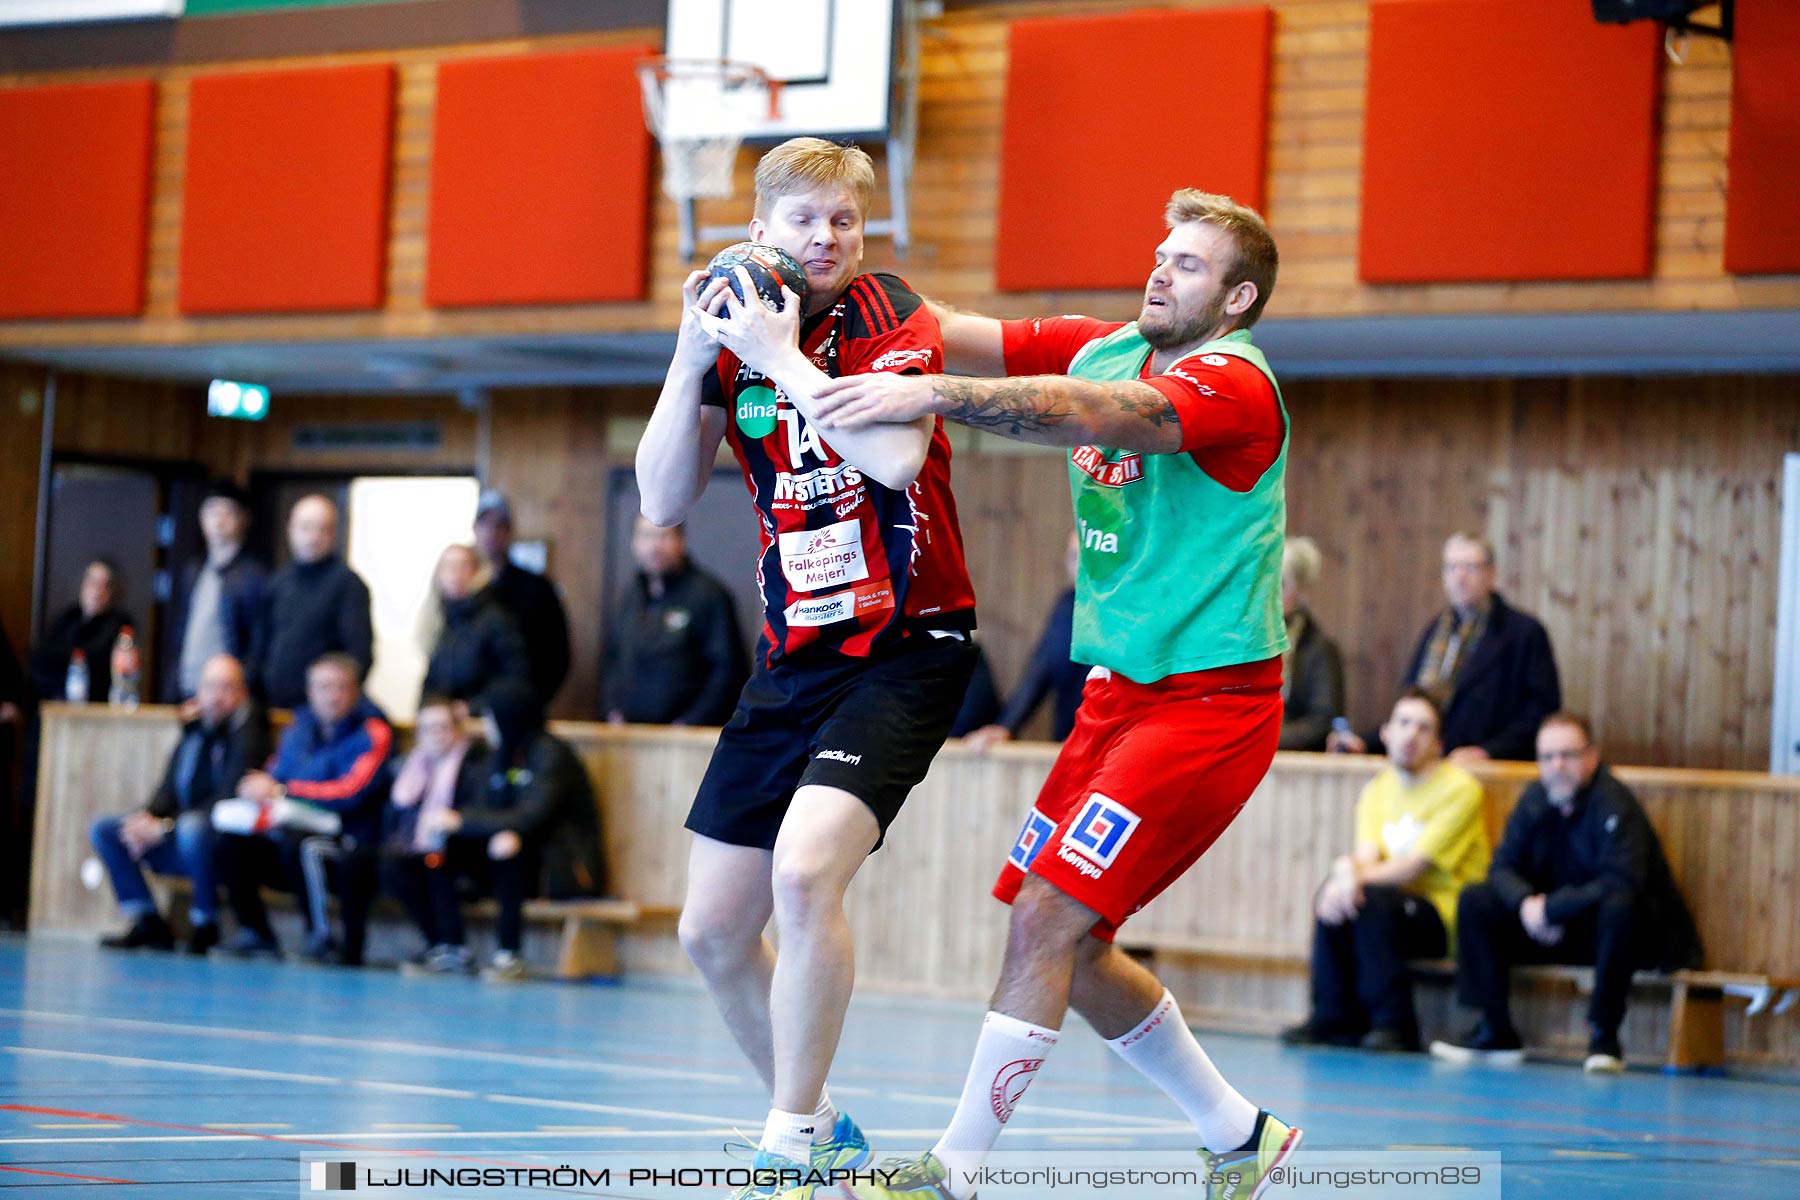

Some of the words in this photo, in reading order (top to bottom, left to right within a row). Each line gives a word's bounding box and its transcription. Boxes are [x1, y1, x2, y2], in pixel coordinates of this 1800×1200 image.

[738, 402, 777, 419] dina
[1079, 518, 1118, 554] ina
[788, 551, 857, 571] Falköpings
[806, 565, 846, 584] Mejeri
[1056, 844, 1104, 880] Kempa
